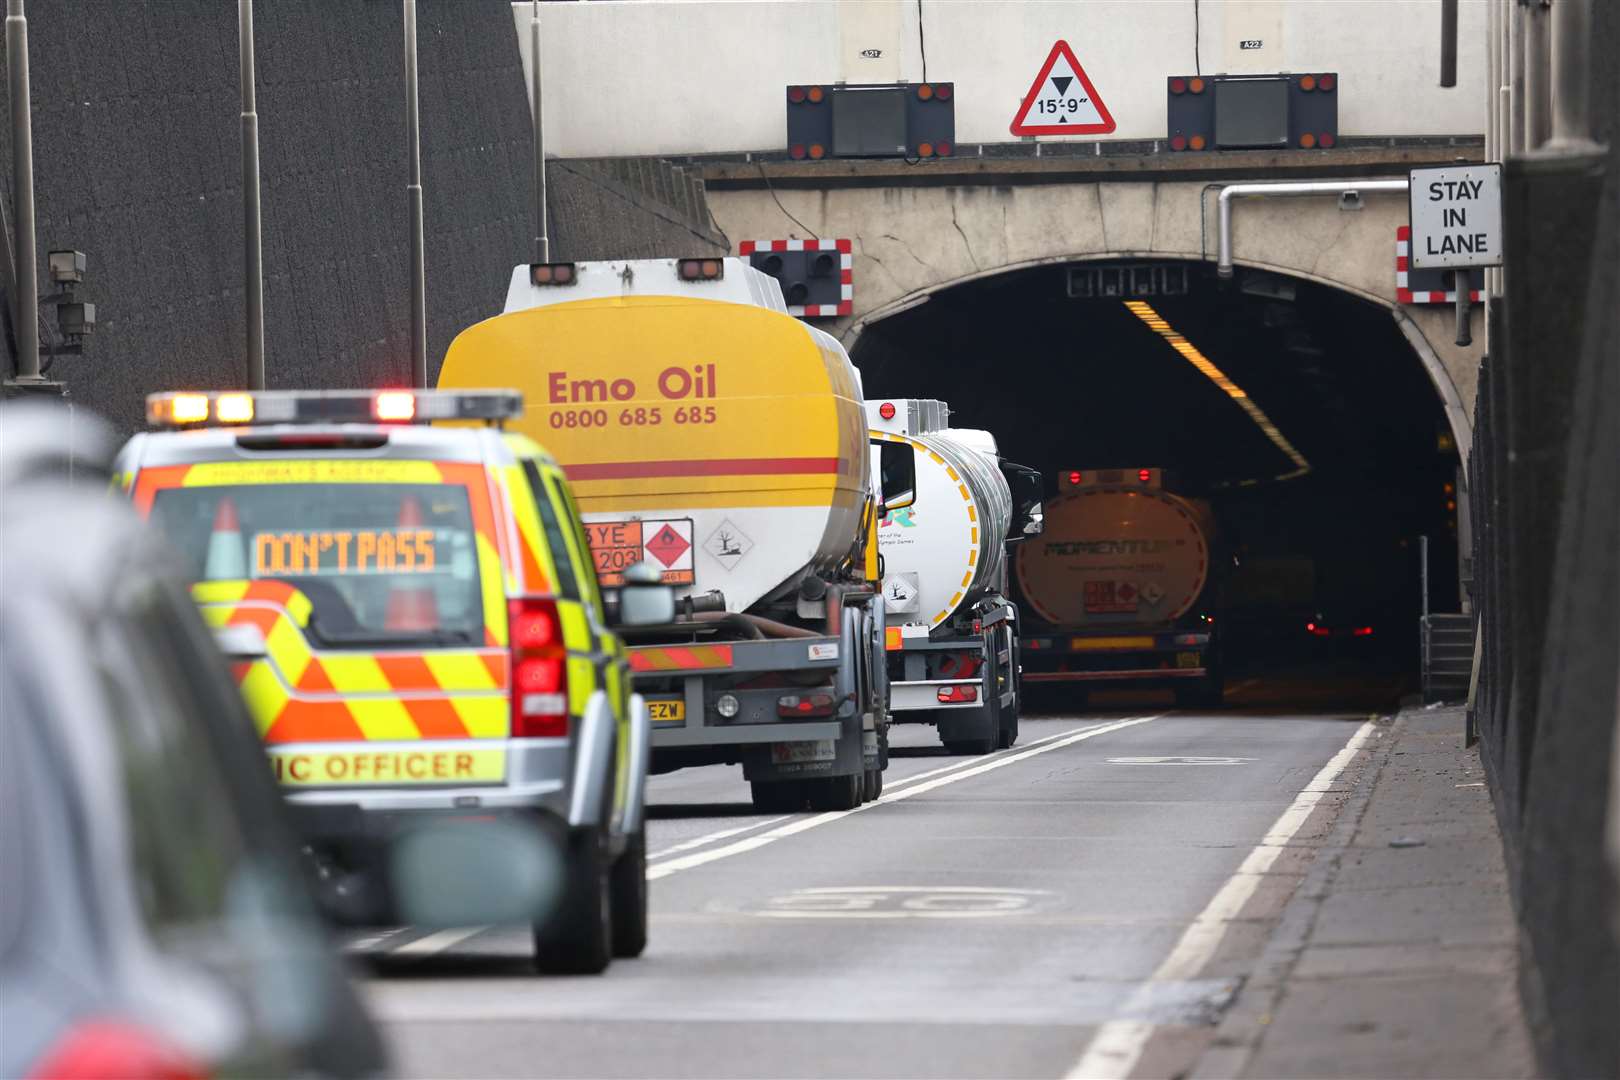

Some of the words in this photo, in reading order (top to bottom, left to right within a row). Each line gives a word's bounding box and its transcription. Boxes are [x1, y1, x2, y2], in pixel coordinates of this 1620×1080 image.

[1428, 180, 1484, 202] STAY
[1443, 207, 1467, 227] IN
[1427, 233, 1488, 255] LANE
[548, 371, 636, 404] Emo
[657, 363, 717, 400] Oil
[549, 409, 608, 429] 0800
[618, 407, 662, 427] 685
[673, 406, 717, 425] 685
[256, 531, 353, 576] DON'T
[356, 530, 435, 573] PASS
[647, 703, 677, 719] EZW
[325, 752, 474, 780] OFFICER
